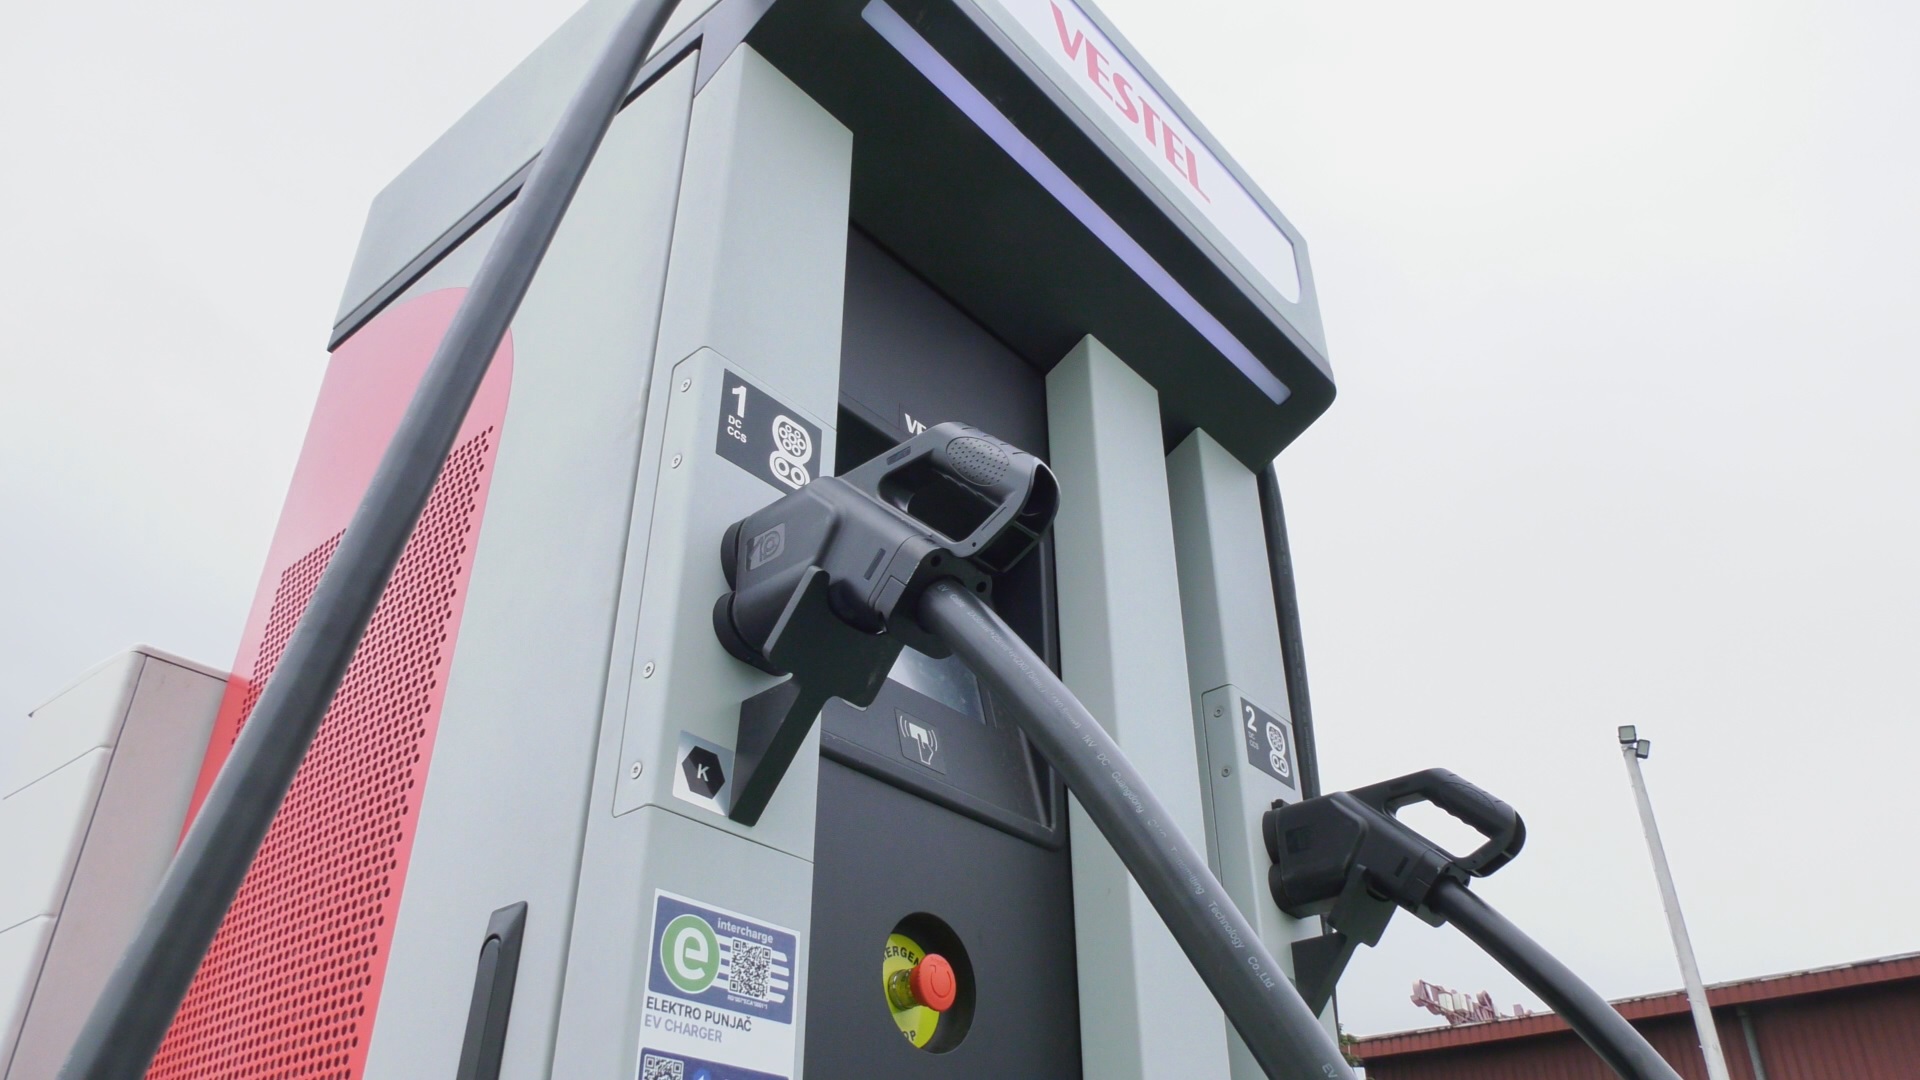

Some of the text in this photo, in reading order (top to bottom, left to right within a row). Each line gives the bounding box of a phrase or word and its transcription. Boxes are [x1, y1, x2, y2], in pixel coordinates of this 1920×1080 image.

[1050, 0, 1211, 204] VESTEL
[732, 386, 747, 418] 1
[727, 427, 747, 444] CCS
[728, 415, 743, 429] DC
[1245, 705, 1257, 732] 2
[697, 763, 710, 782] K
[1097, 752, 1111, 766] DC
[1111, 771, 1145, 814] Guangdong
[1208, 900, 1245, 949] Technology
[717, 918, 774, 945] intercharge
[646, 996, 702, 1021] ELEKTRO
[704, 1010, 752, 1032] PUNJAČ
[644, 1014, 723, 1043] EV CHARGER
[1321, 1062, 1338, 1079] EV
